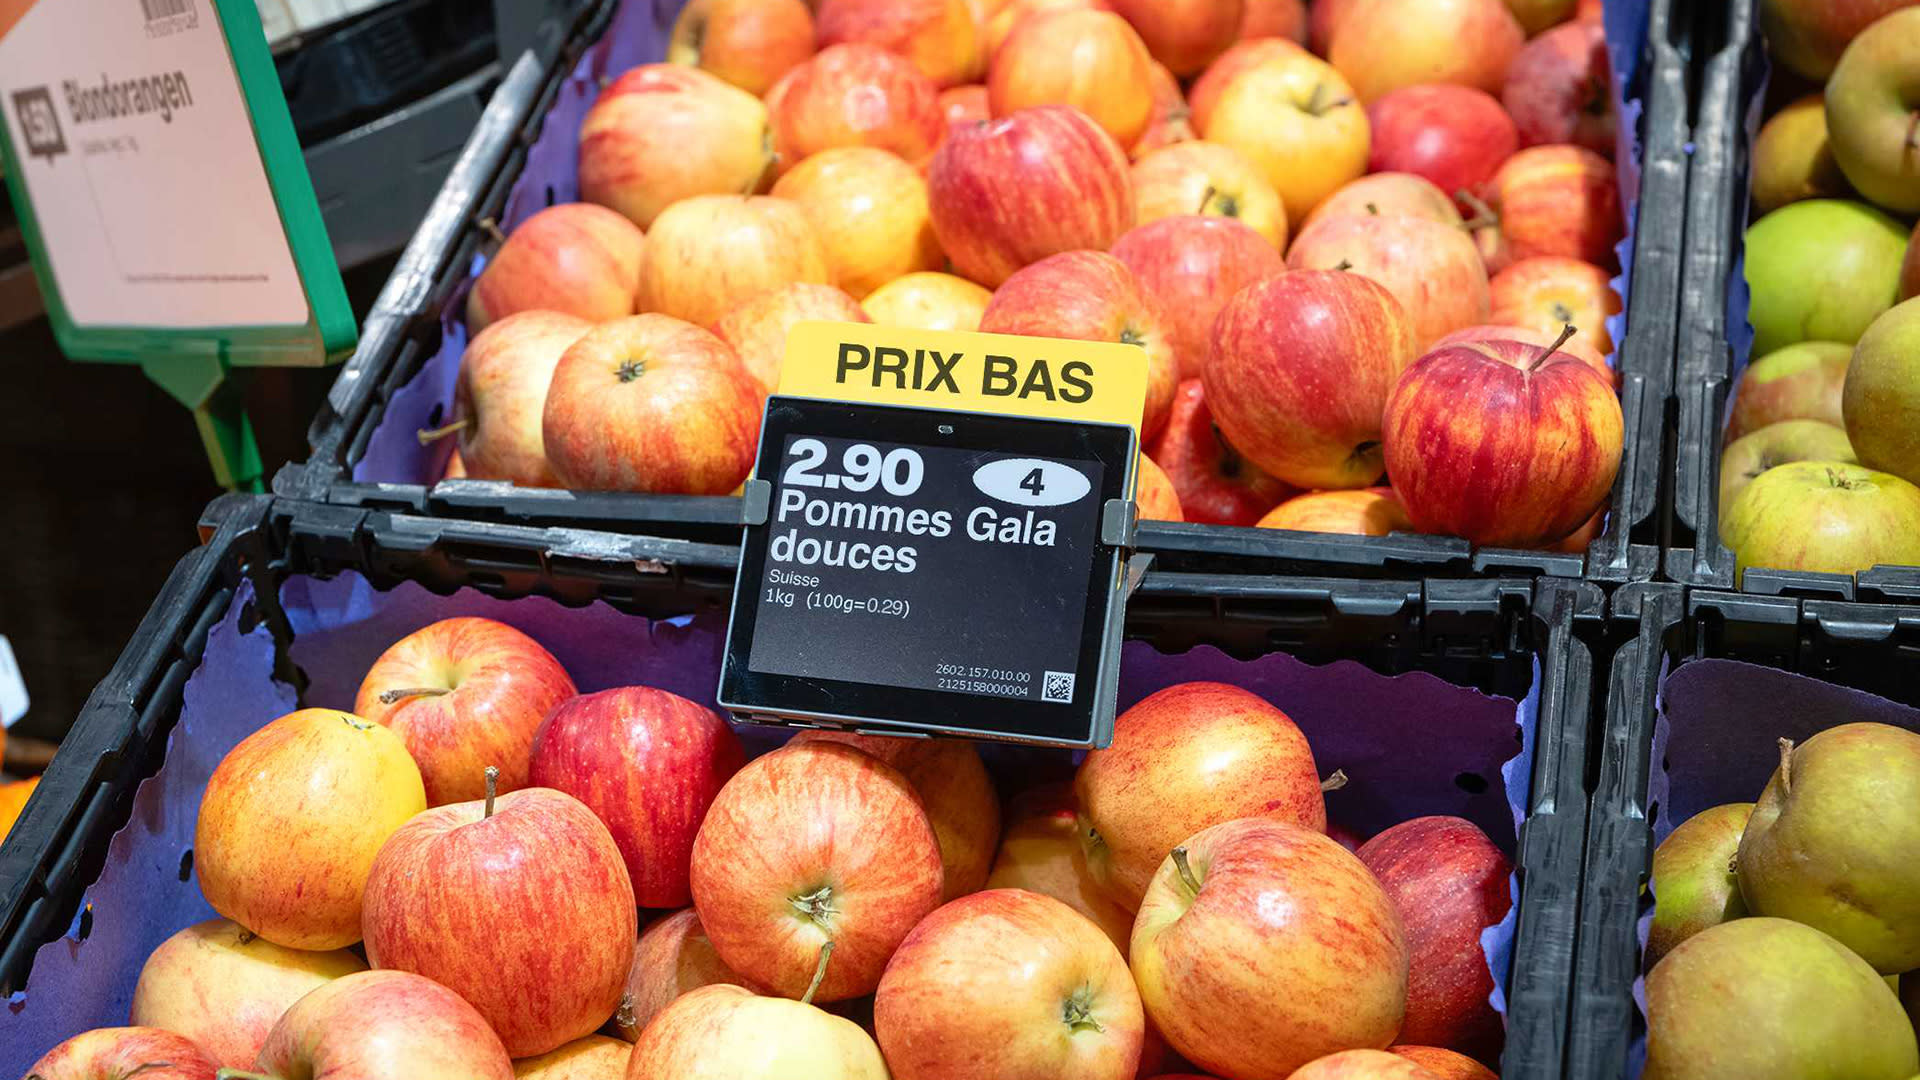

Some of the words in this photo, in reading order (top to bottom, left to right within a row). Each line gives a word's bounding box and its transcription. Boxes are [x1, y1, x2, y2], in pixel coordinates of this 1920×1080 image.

[836, 343, 964, 394] PRIX
[981, 354, 1095, 404] BAS
[783, 438, 925, 497] 2.90
[1019, 468, 1045, 496] 4
[777, 489, 952, 536] Pommes
[966, 506, 1057, 546] Gala
[770, 529, 918, 573] douces
[768, 569, 820, 587] Suisse
[765, 588, 795, 608] 1kg
[806, 591, 911, 619] (100g=0.29)
[935, 663, 1031, 683] 2602.157.010.00
[937, 677, 1028, 696] 2125158000004
